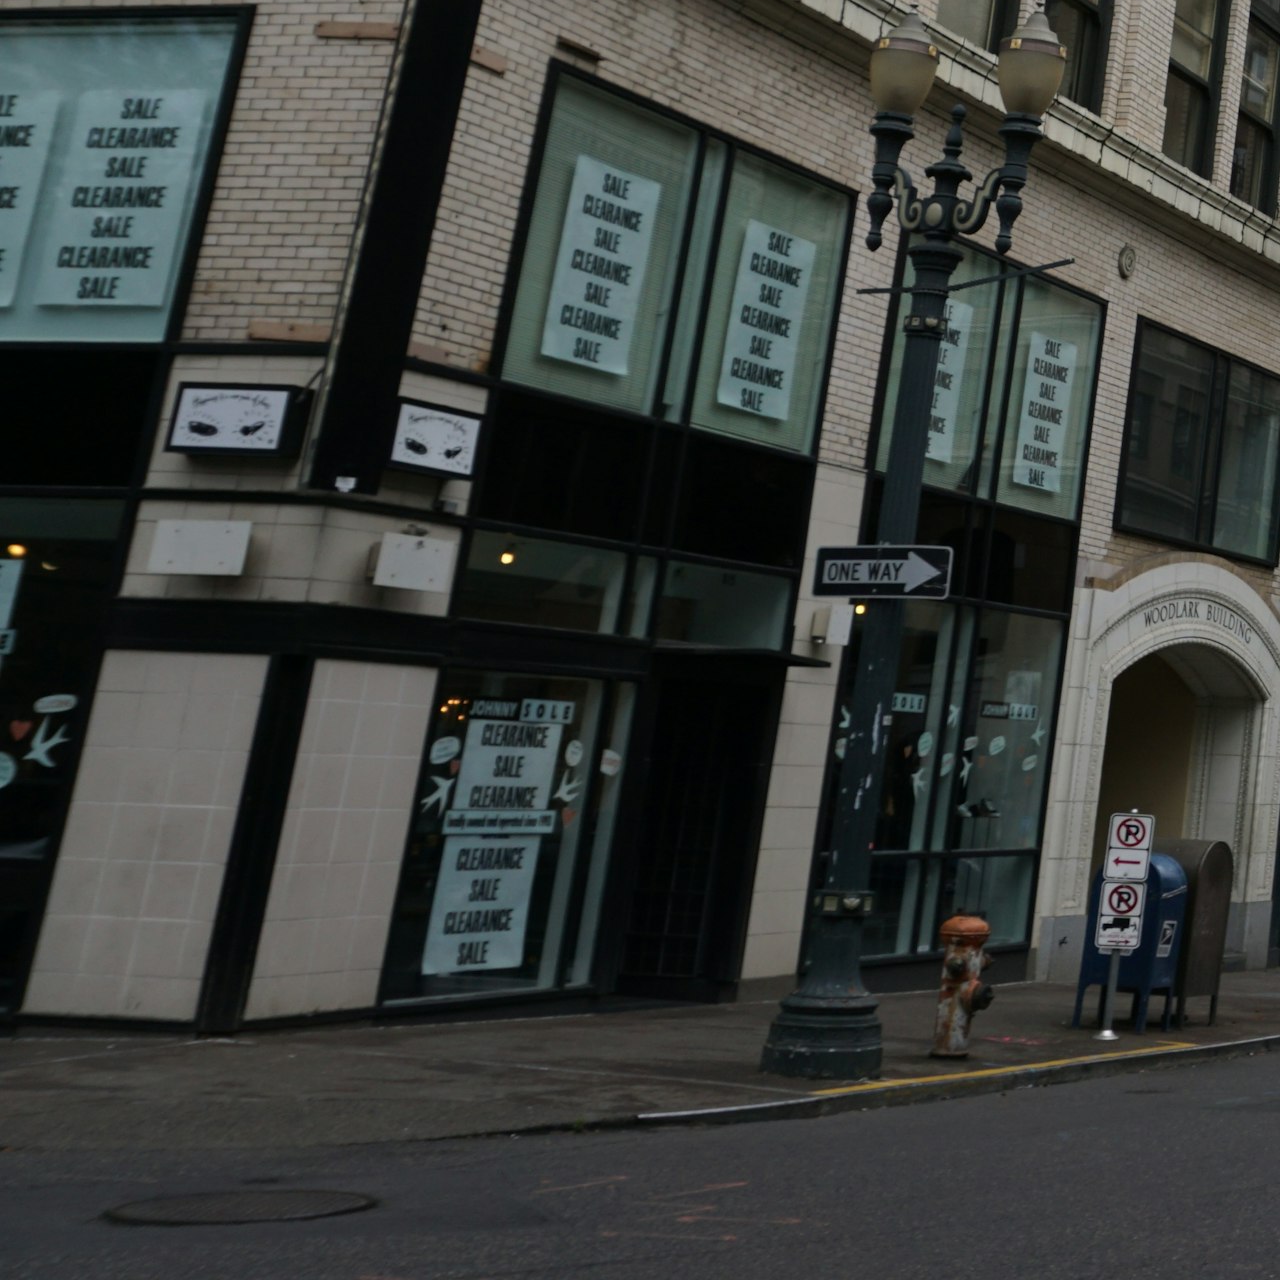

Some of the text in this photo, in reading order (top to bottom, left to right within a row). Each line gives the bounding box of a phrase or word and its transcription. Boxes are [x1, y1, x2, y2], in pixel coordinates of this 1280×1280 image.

[121, 98, 163, 119] SALE
[86, 127, 181, 149] CLEARANCE
[105, 156, 148, 178] SALE
[71, 186, 167, 208] CLEARANCE
[602, 174, 630, 200] SALE
[582, 194, 643, 232] CLEARANCE
[91, 216, 134, 238] SALE
[594, 227, 621, 254] SALE
[768, 231, 793, 257] SALE
[57, 246, 154, 268] CLEARANCE
[571, 249, 632, 286] CLEARANCE
[750, 252, 802, 288] CLEARANCE
[77, 277, 120, 299] SALE
[584, 282, 610, 308] SALE
[759, 284, 784, 308] SALE
[560, 304, 623, 340] CLEARANCE
[740, 304, 791, 338] CLEARANCE
[573, 337, 602, 363] SALE
[749, 335, 772, 359] SALE
[1044, 339, 1062, 360] SALE
[730, 357, 784, 390] CLEARANCE
[1033, 358, 1068, 383] CLEARANCE
[740, 387, 764, 412] SALE
[1039, 382, 1056, 402] SALE
[1028, 401, 1063, 425] CLEARANCE
[1033, 425, 1050, 444] SALE
[1023, 444, 1058, 468] CLEARANCE
[1028, 468, 1045, 487] SALE
[828, 562, 903, 581] ONE WAY
[1144, 601, 1252, 643] WOODLARK BUILDING
[469, 700, 519, 717] JOHNNY
[481, 724, 549, 748] CLEARANCE
[493, 755, 525, 778] SALE
[469, 786, 538, 808] CLEARANCE
[456, 847, 525, 871] CLEARANCE
[468, 879, 501, 902] SALE
[443, 909, 513, 934] CLEARANCE
[457, 941, 488, 966] SALE
